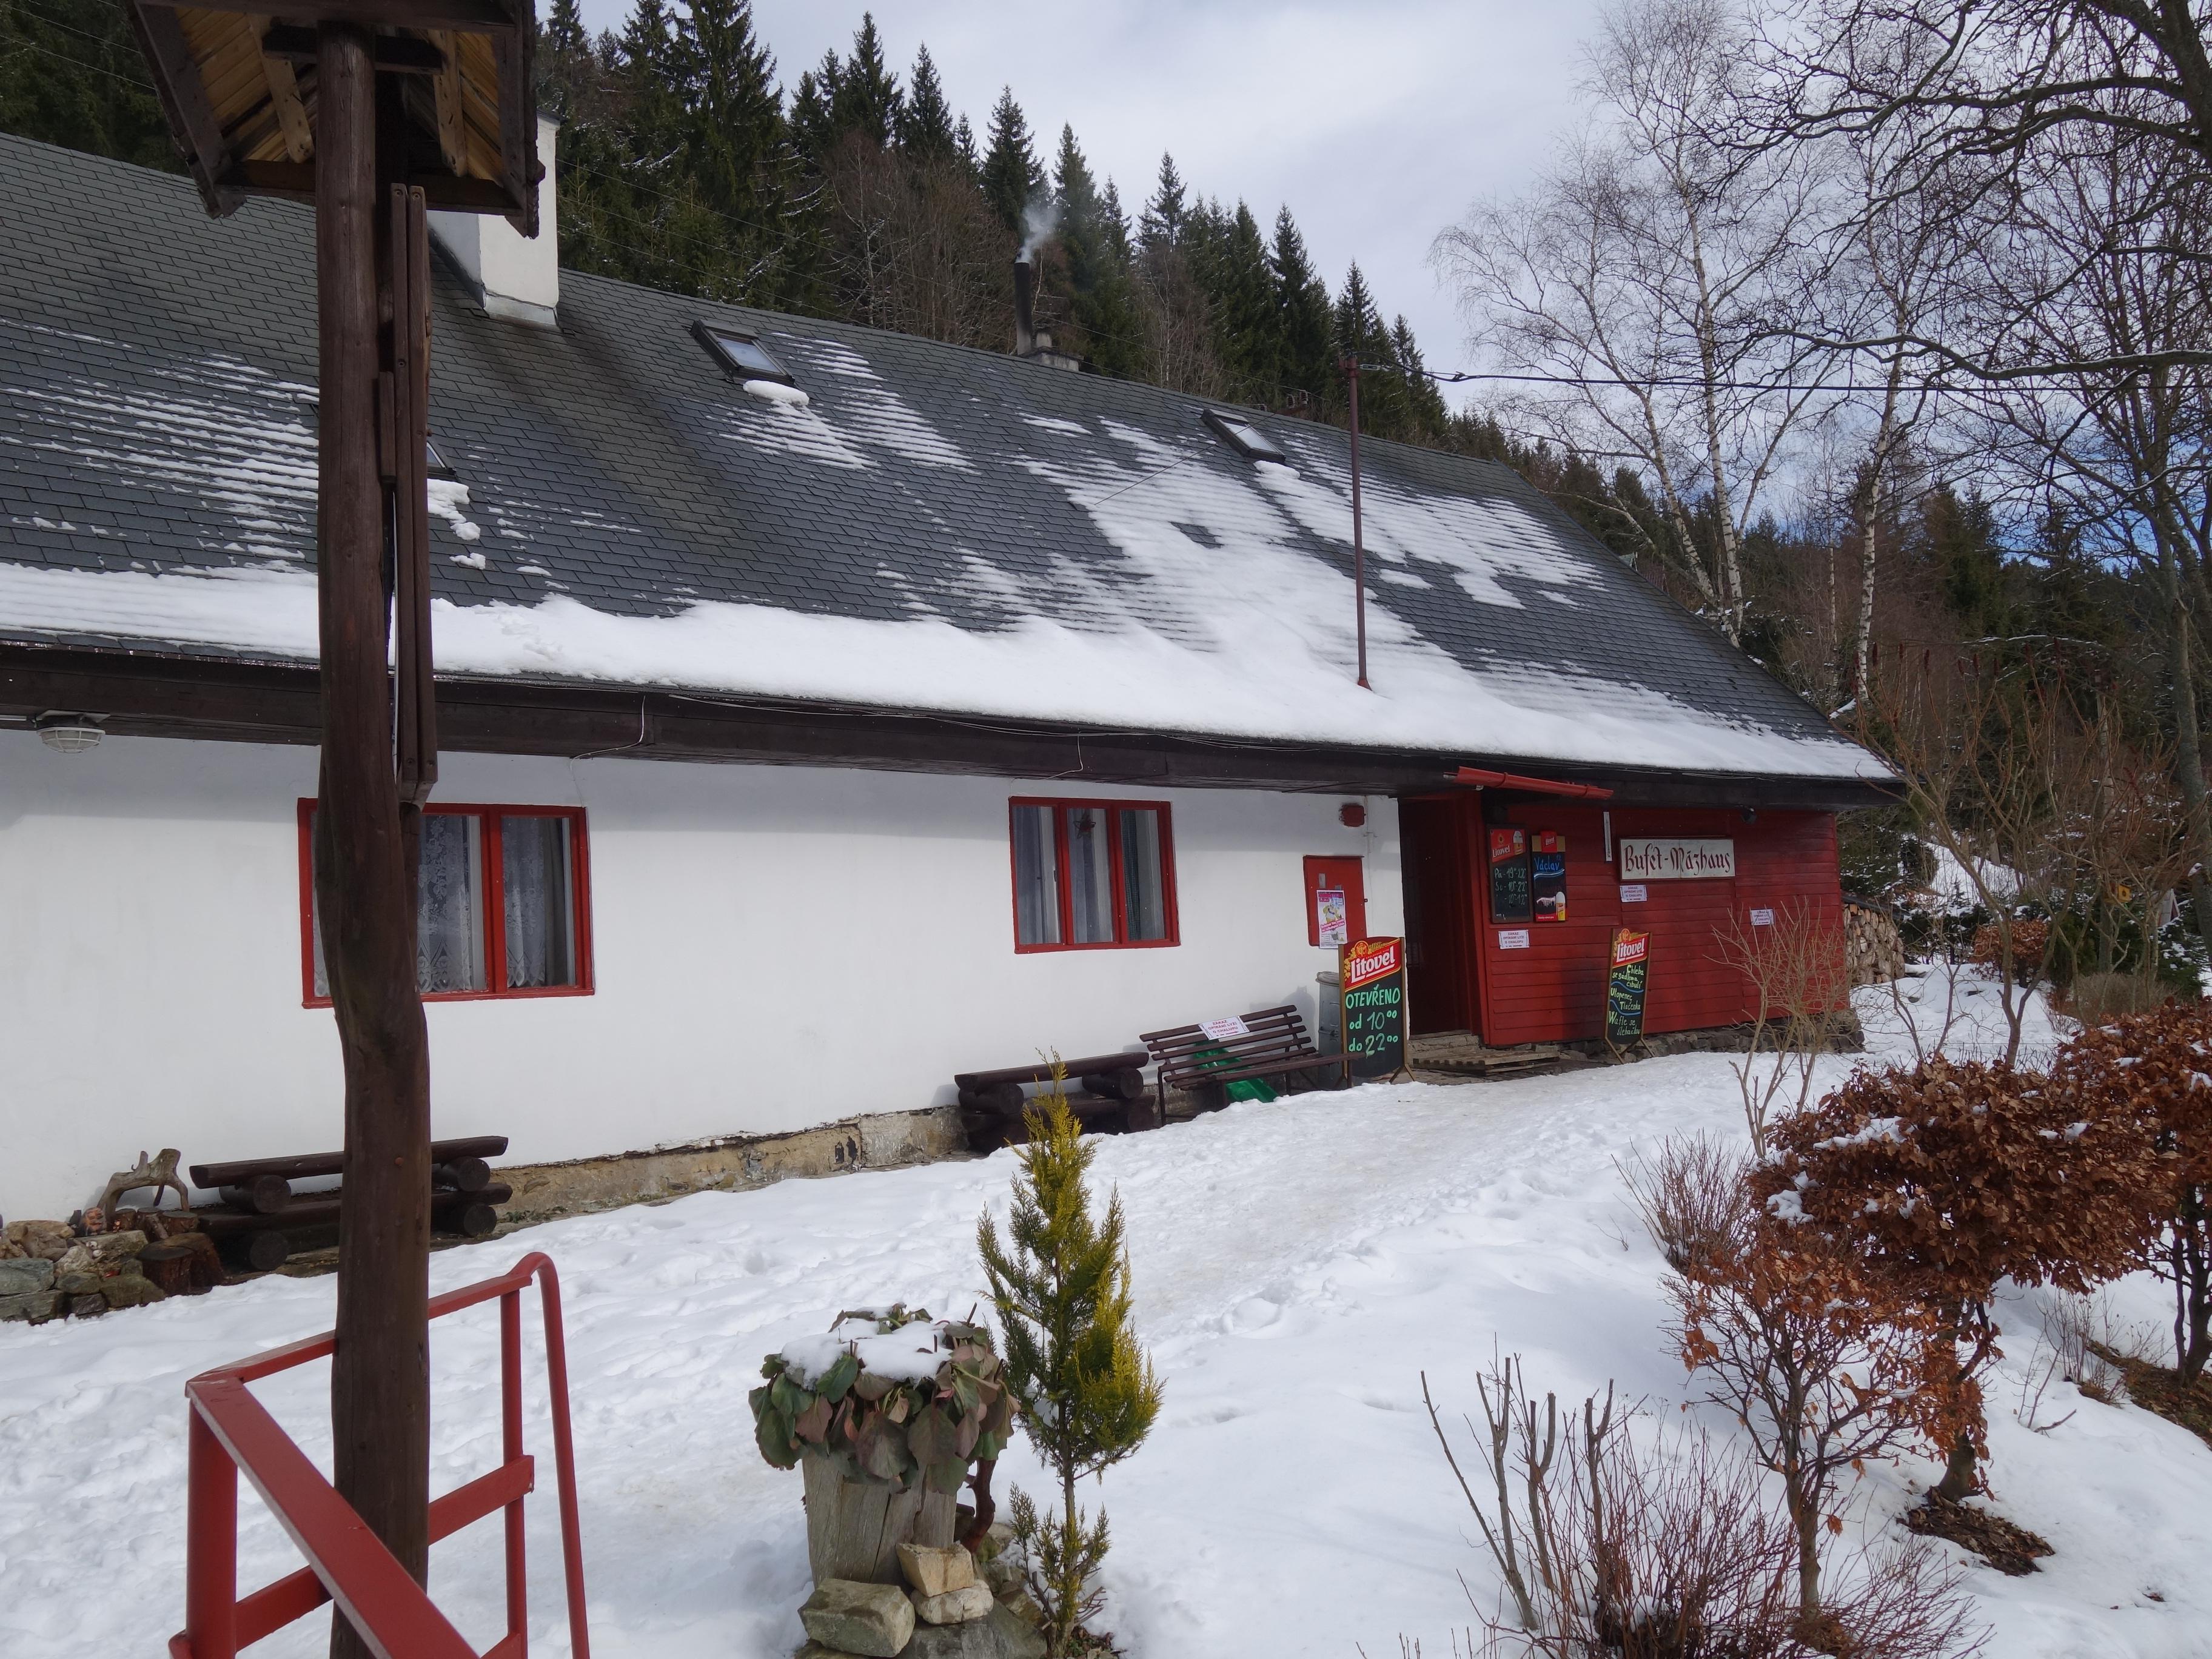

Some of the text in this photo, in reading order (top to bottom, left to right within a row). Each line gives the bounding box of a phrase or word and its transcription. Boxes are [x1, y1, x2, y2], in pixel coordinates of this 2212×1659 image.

[1492, 845, 1510, 858] Litovel
[1616, 938, 1645, 963] Litovel
[1351, 945, 1395, 984] Litovel
[1626, 964, 1644, 976] Chleba
[1346, 984, 1401, 1010] OTEVŘENO
[1349, 1013, 1362, 1030] od
[1609, 1011, 1627, 1026] Wafle
[1349, 1037, 1362, 1052] do
